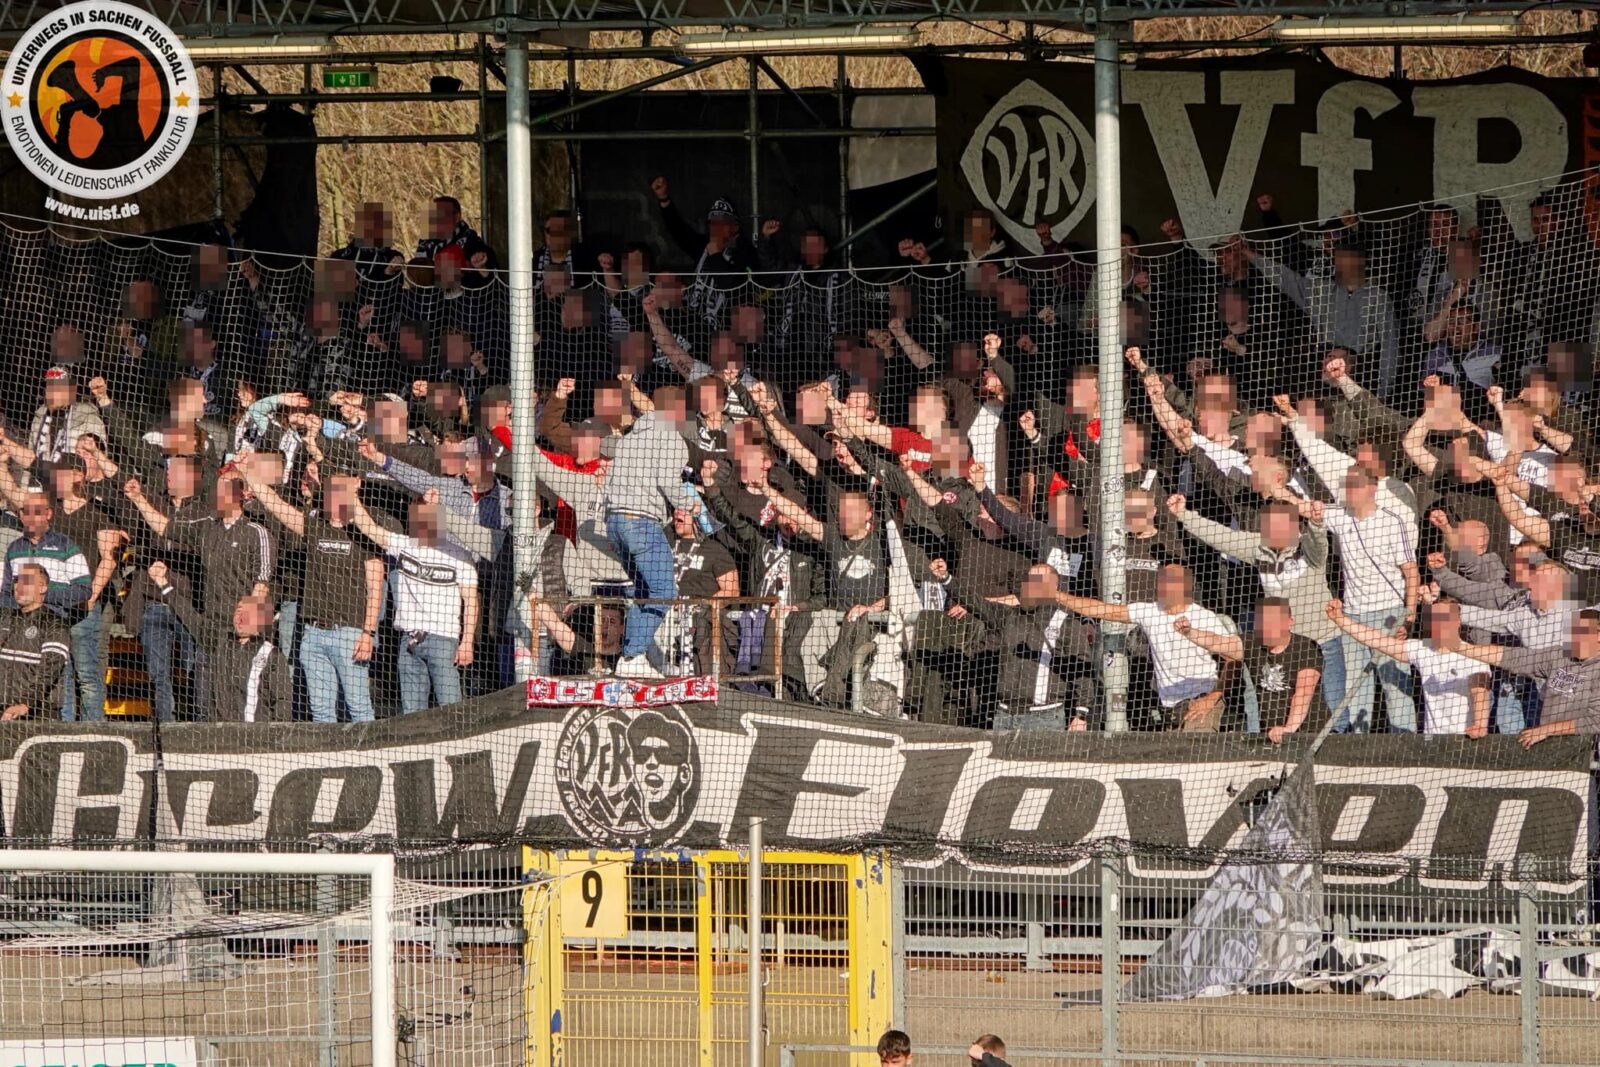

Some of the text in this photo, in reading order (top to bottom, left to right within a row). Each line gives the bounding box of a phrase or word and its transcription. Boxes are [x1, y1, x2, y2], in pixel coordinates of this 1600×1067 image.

[1121, 69, 1568, 258] VfR
[10, 720, 1585, 884] Crew Eleven
[582, 870, 603, 928] 9
